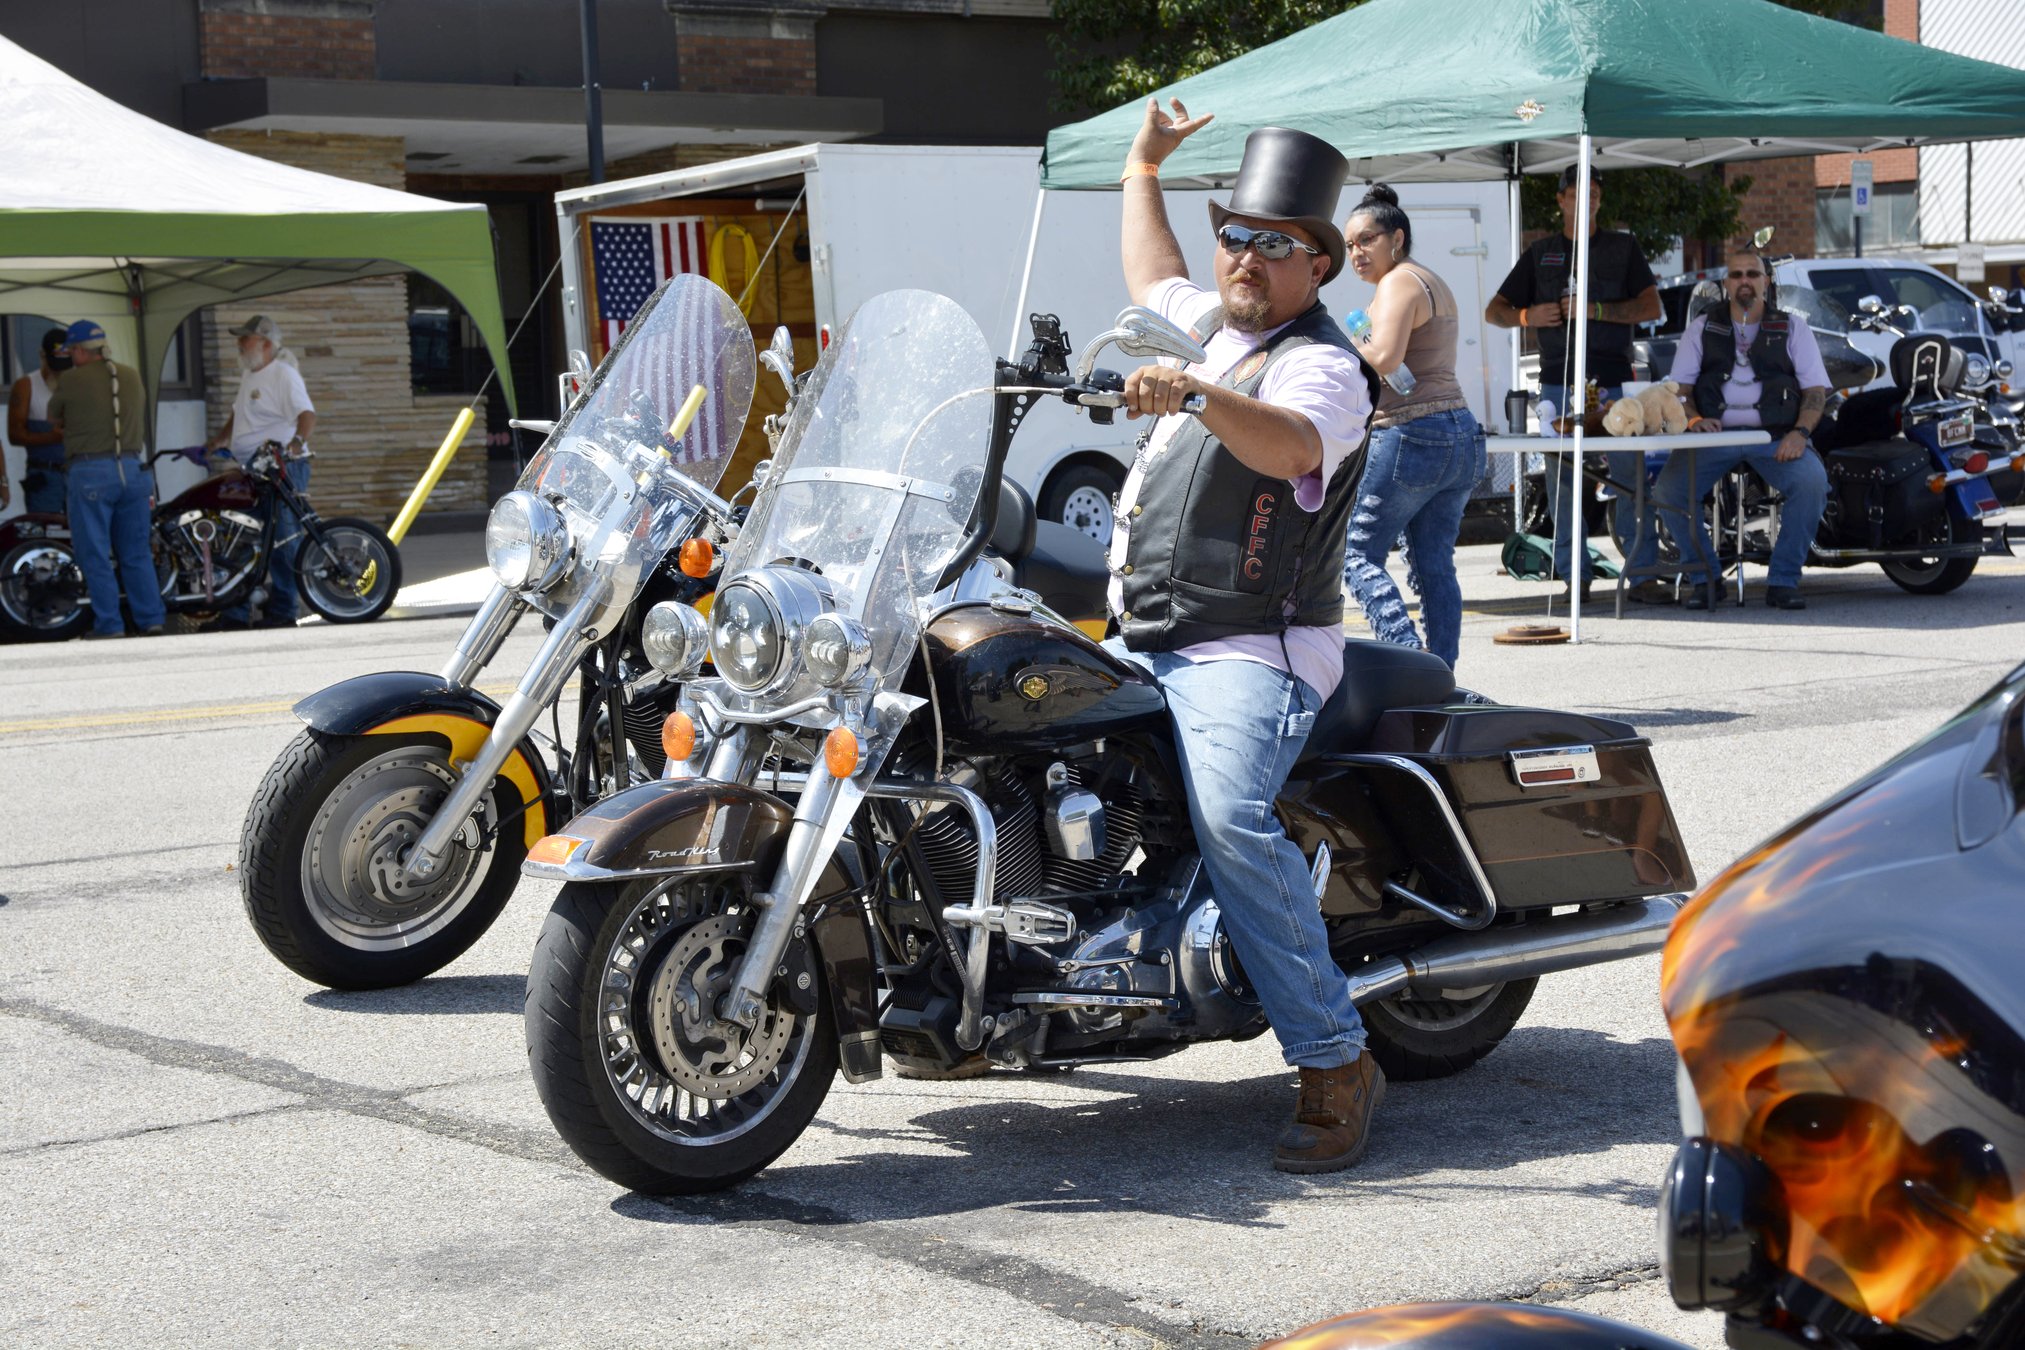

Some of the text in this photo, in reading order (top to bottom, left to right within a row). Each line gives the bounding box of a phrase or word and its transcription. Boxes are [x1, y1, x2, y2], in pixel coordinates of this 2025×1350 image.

[1244, 493, 1275, 581] CFFC
[648, 847, 721, 861] Road King
